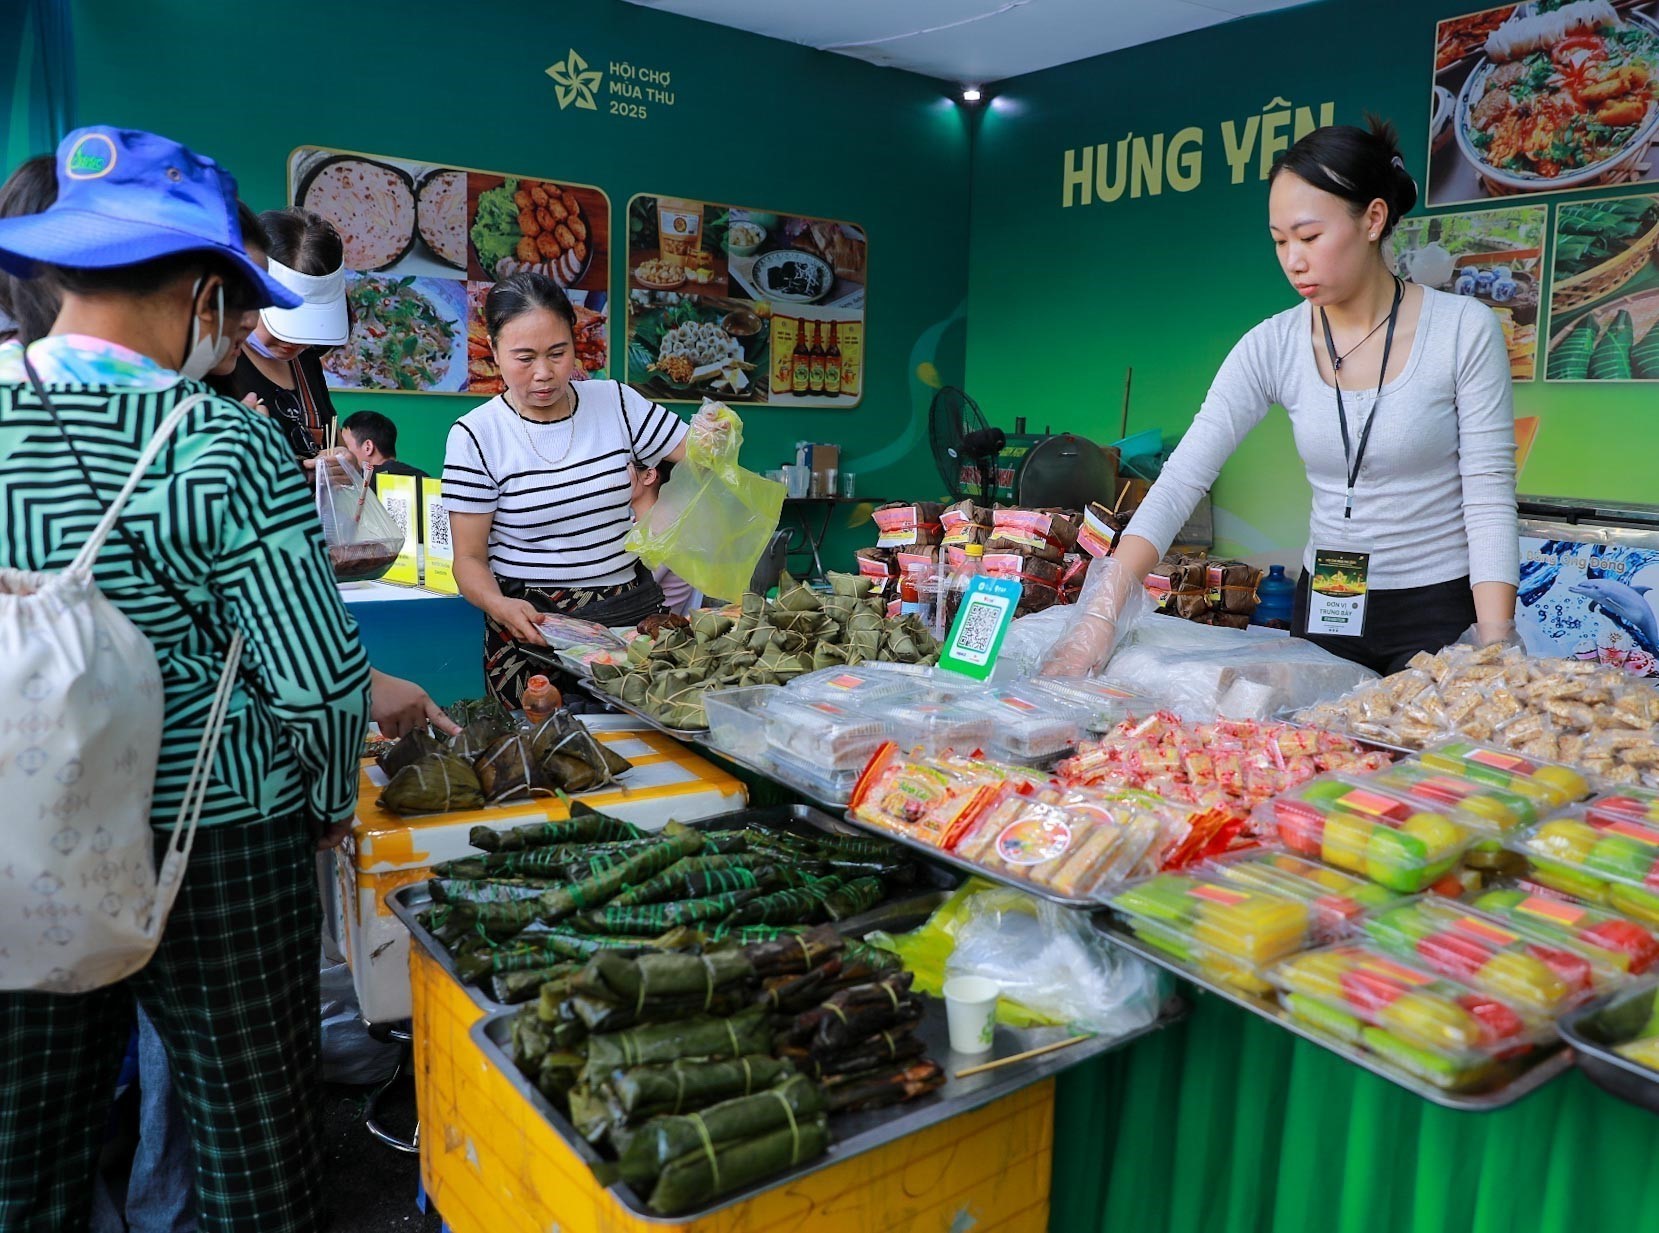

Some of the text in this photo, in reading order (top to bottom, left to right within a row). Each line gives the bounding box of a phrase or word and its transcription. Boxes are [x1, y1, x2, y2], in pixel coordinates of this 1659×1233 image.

[610, 61, 671, 88] HỘI CHỢ
[610, 81, 675, 105] MÙA THU
[610, 101, 647, 119] 2025
[1062, 126, 1204, 208] HƯNG
